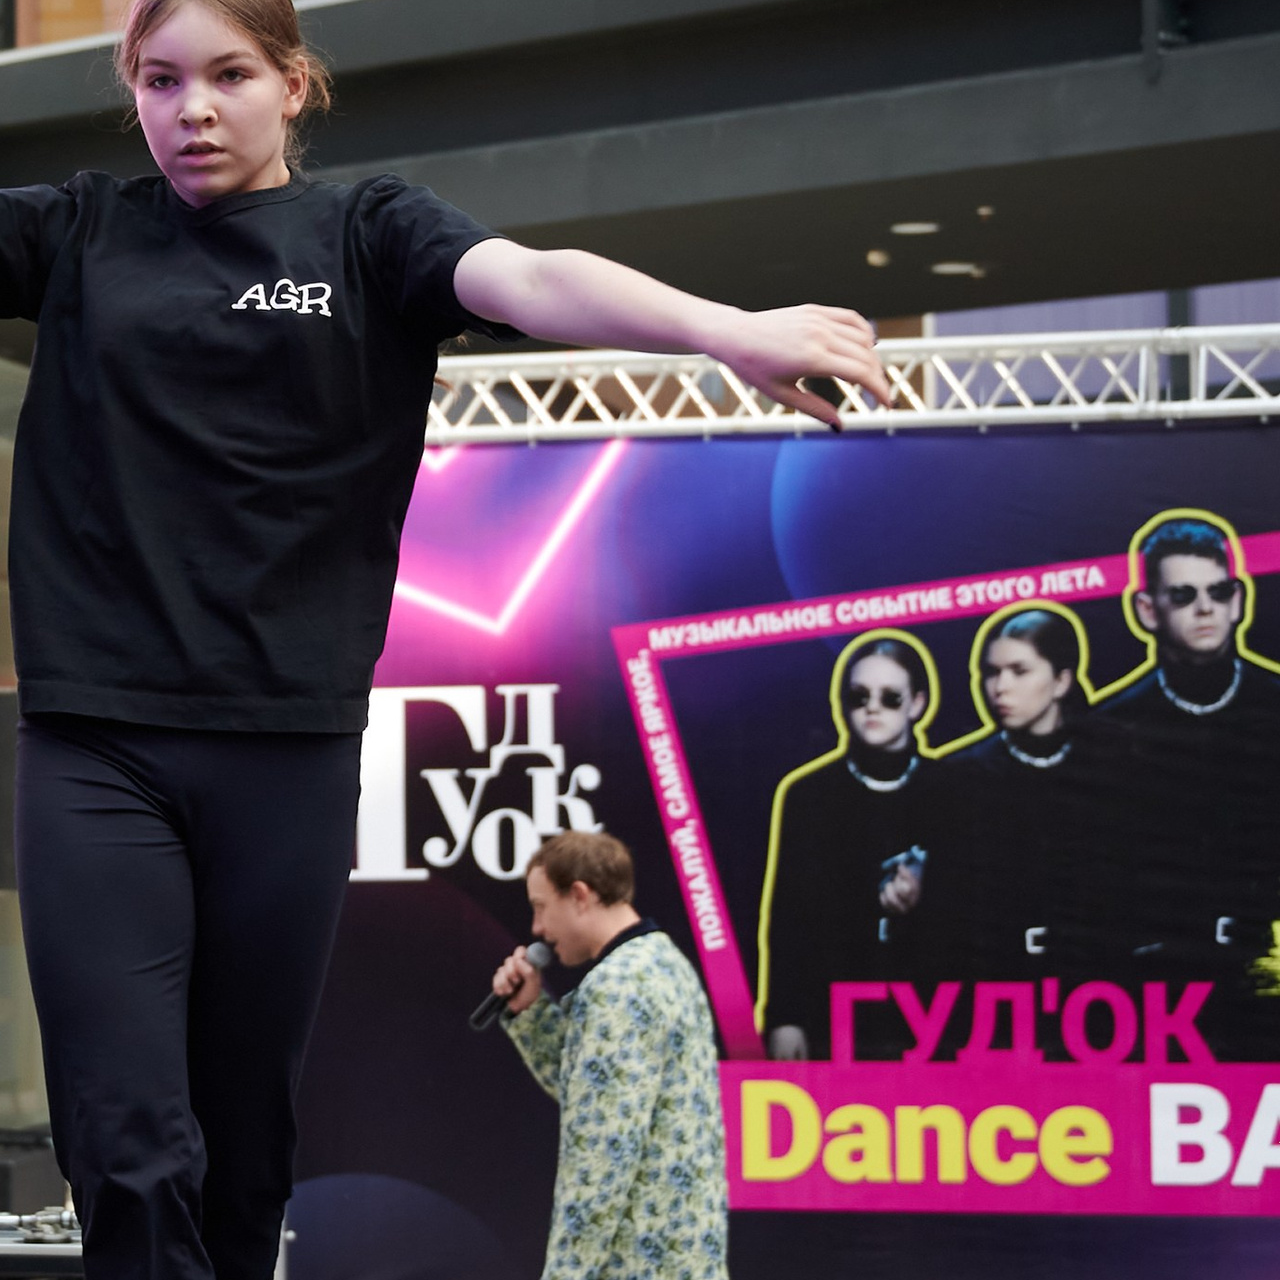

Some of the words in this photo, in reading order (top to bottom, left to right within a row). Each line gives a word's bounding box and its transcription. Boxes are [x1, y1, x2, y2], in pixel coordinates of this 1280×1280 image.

[231, 278, 333, 318] AGR
[648, 602, 833, 650] МУЗЫКАЛЬНОЕ
[835, 585, 953, 625] СОБЫТИЕ
[955, 575, 1035, 607] ЭТОГО
[1039, 565, 1106, 595] ЛЕТА
[626, 648, 667, 734] ЯРКОЕ,
[648, 732, 690, 820] САМОЕ
[670, 818, 727, 953] ПОЖАЛУЙ,
[741, 1079, 1114, 1187] Dance
